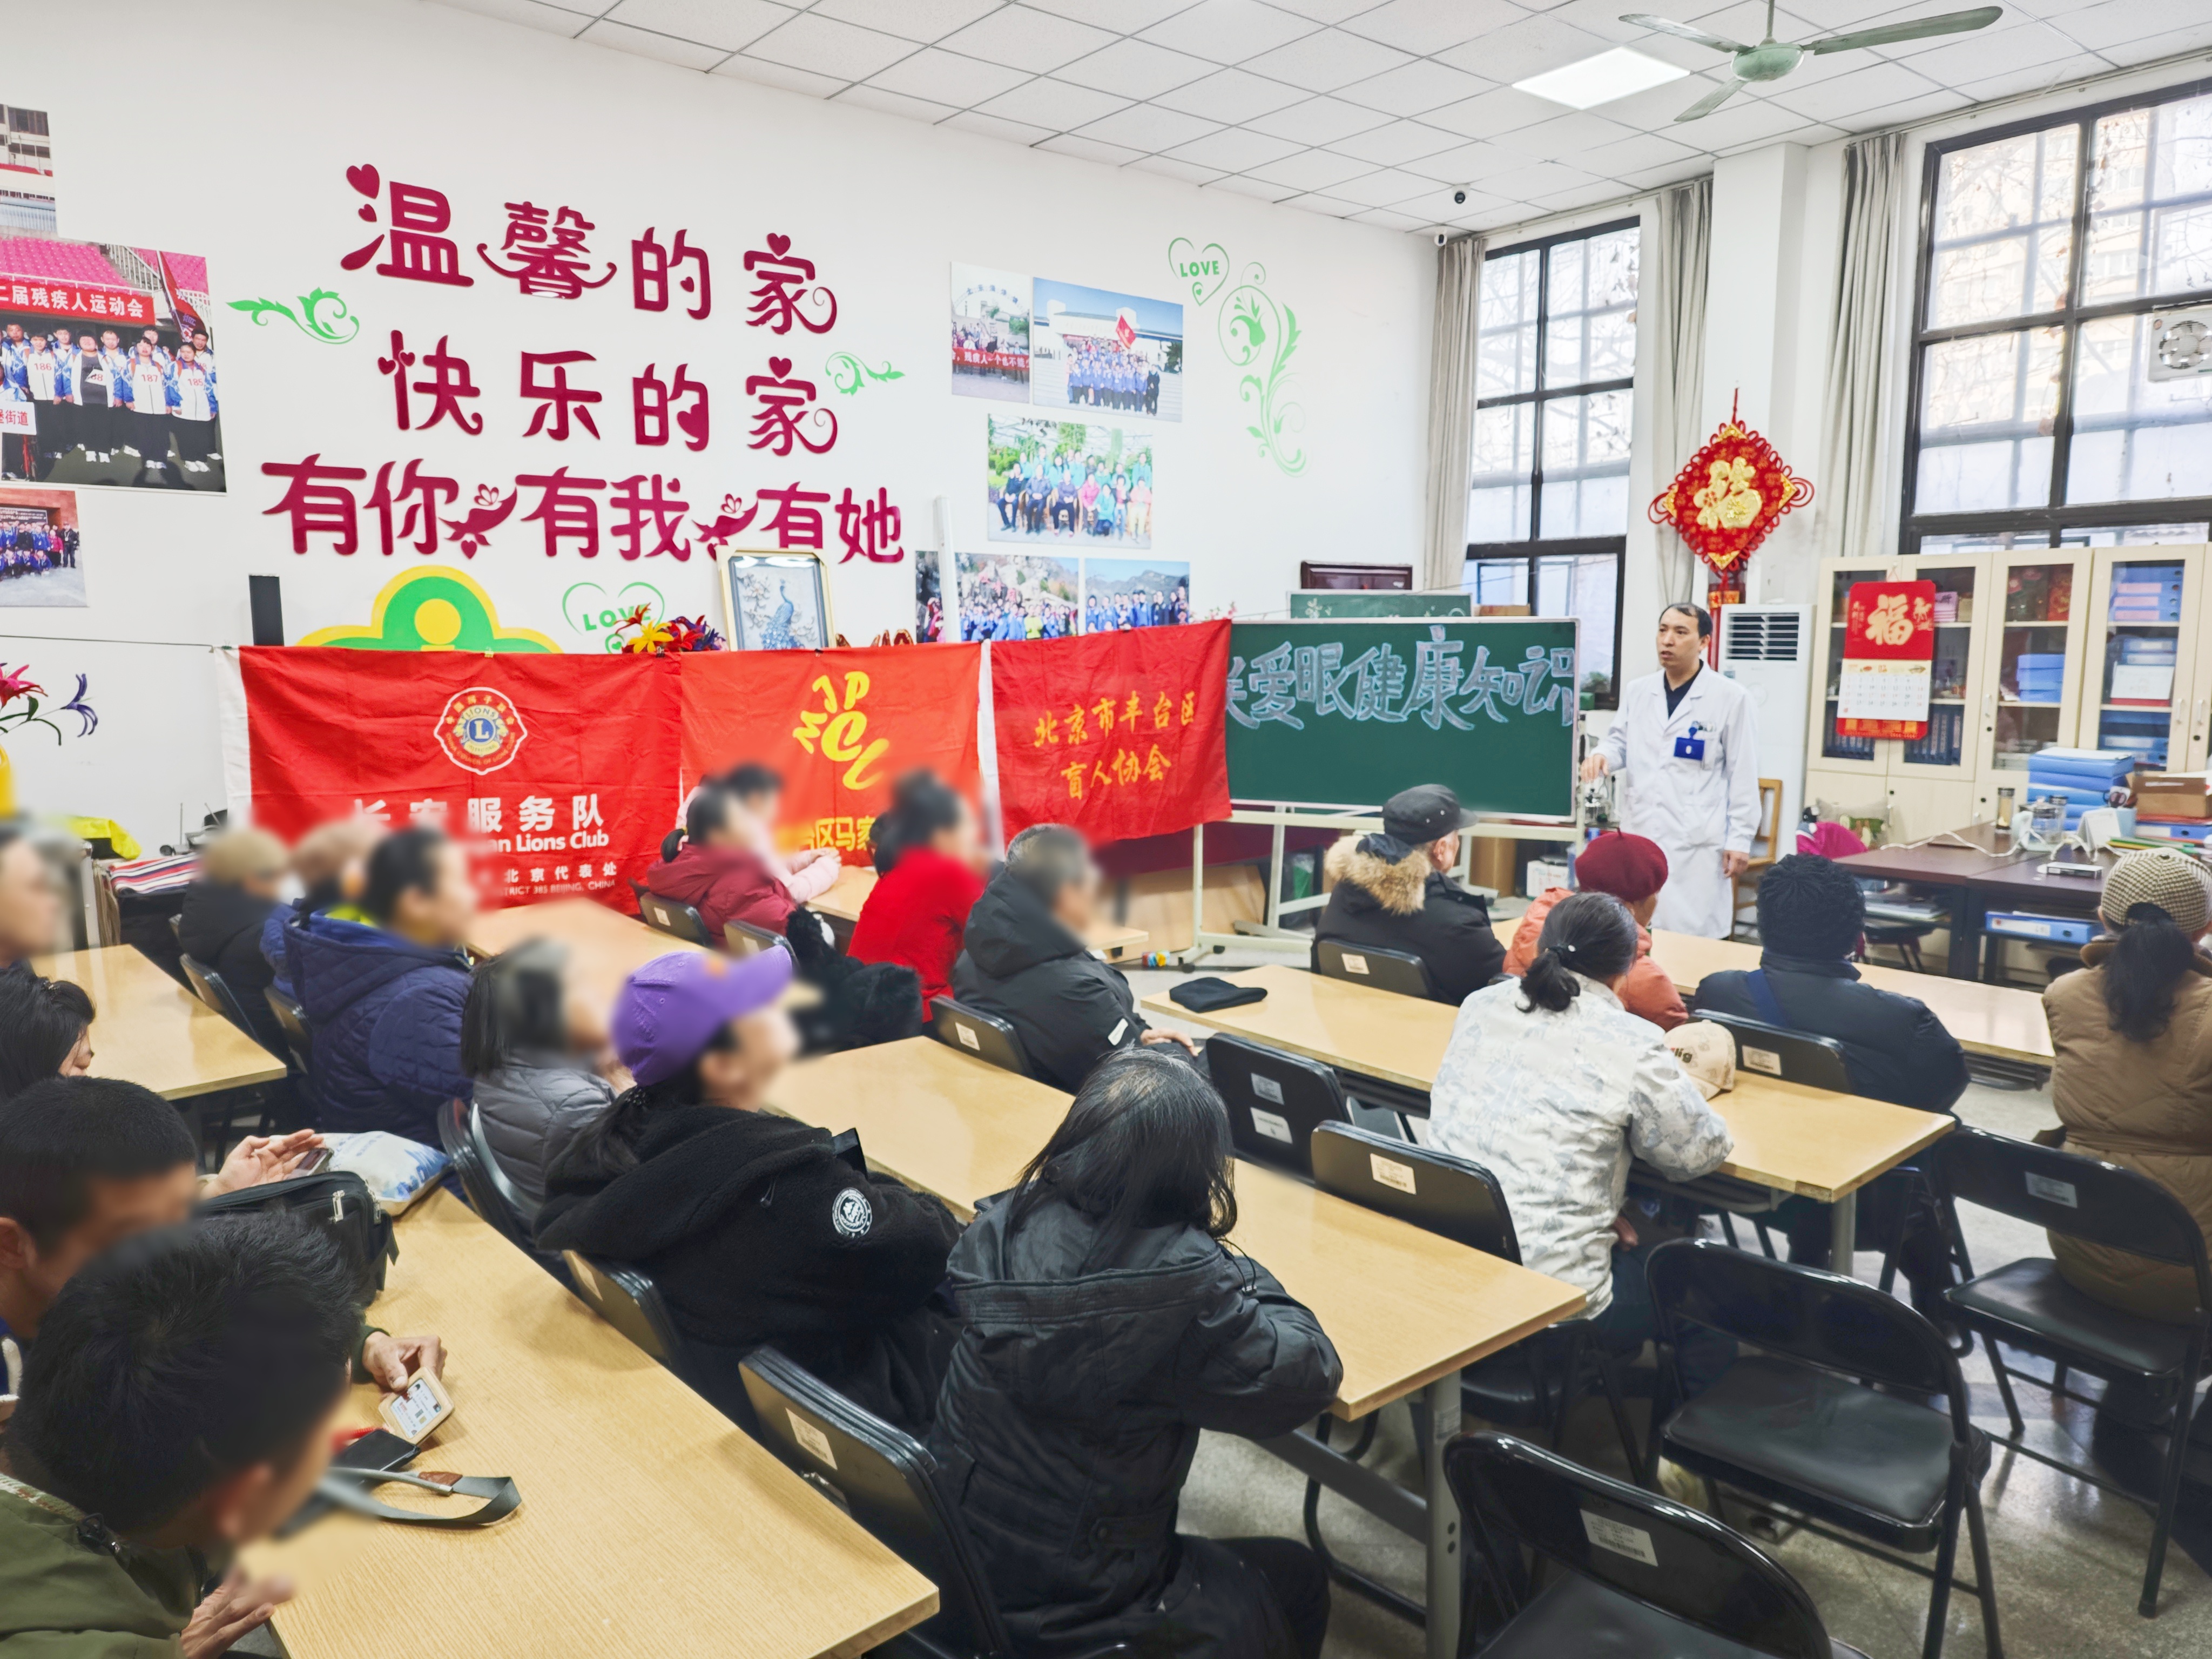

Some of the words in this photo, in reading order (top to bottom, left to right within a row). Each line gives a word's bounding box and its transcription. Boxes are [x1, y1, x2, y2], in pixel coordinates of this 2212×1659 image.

[341, 164, 837, 335] 温馨的家
[1179, 260, 1220, 278] LOVE
[34, 363, 52, 371] 186
[141, 374, 158, 382] 187
[187, 378, 204, 387] 185
[378, 331, 837, 456] 快乐的家
[1865, 594, 1914, 645] 福
[466, 707, 496, 719] LIONS
[1034, 690, 1195, 747] 北京市丰台区
[474, 720, 490, 740] L
[1061, 744, 1171, 800] 盲人协会
[516, 833, 565, 852] Lions
[570, 829, 609, 849] Club
[504, 861, 617, 884] 北京代表处
[503, 886, 531, 896] TRICT
[588, 879, 615, 891] CHINA
